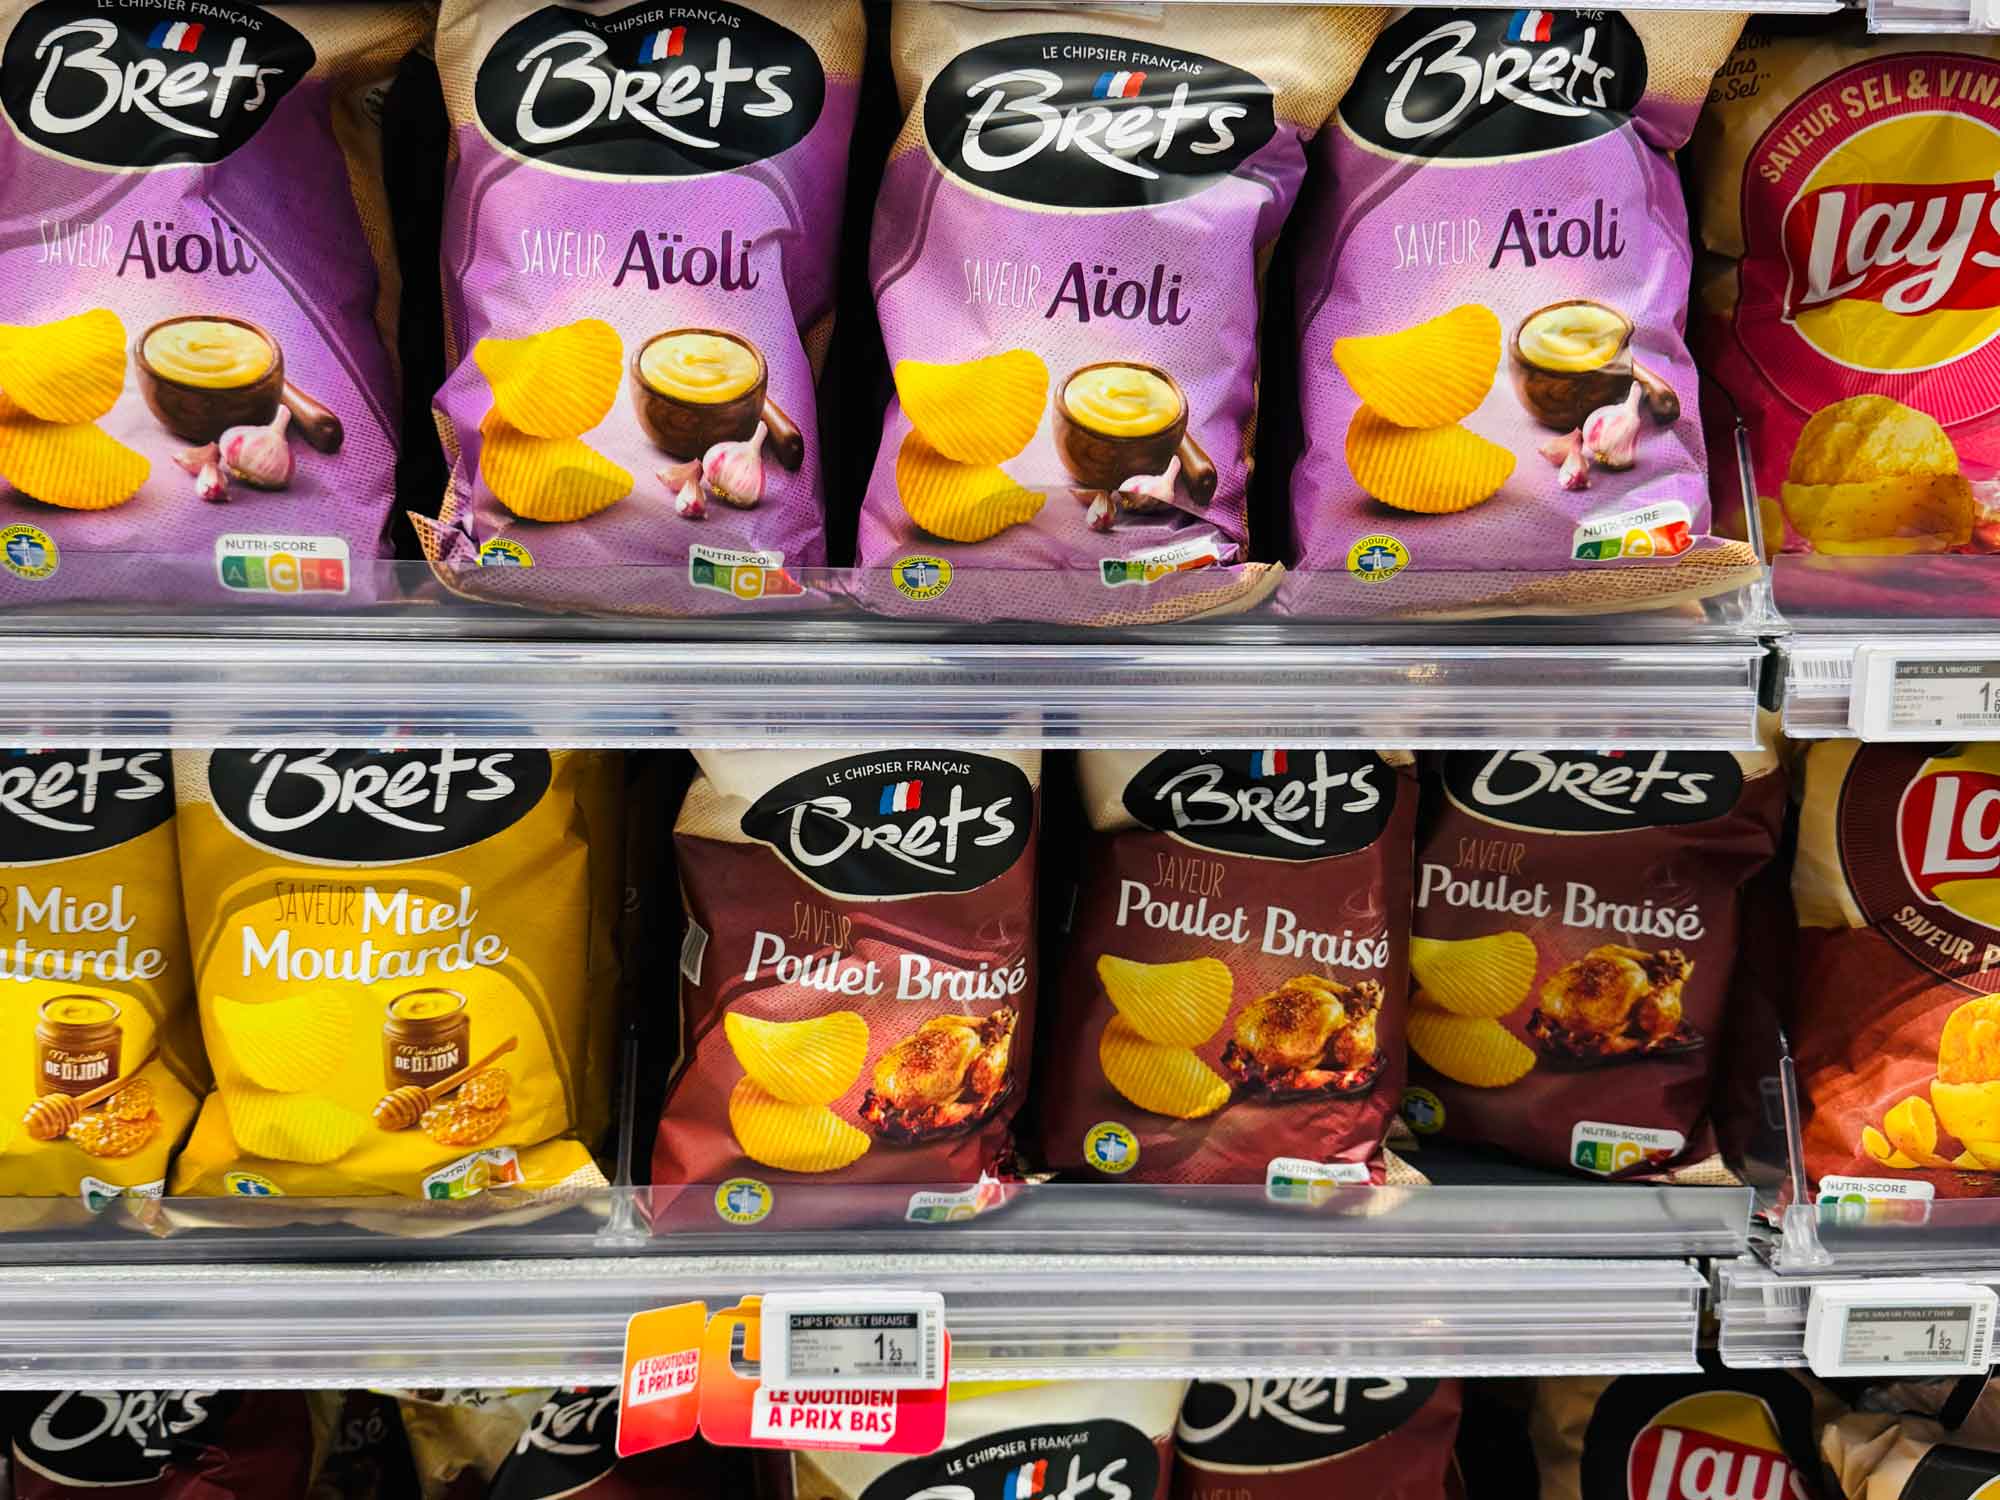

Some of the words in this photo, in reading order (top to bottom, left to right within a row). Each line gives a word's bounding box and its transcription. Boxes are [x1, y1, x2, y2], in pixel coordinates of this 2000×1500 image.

[190, 2, 264, 31] FRANÇAIS
[604, 9, 664, 34] CHIPSIER
[669, 7, 741, 29] FRANÇAIS
[30, 18, 284, 139] Brets
[1042, 46, 1058, 60] LE
[1063, 46, 1128, 63] CHIPSIER
[1131, 52, 1203, 75] FRANÇAIS
[1384, 20, 1615, 139] Brets
[517, 30, 793, 148] Brets
[961, 69, 1247, 180] Brets
[1760, 104, 1840, 183] SAVEUR
[1840, 73, 1902, 119] SEL
[1907, 69, 1929, 99] &
[37, 219, 115, 268] SAVEUR
[117, 216, 259, 280] Aïoli
[1393, 219, 1481, 270] SAVEUR
[1488, 199, 1625, 270] Aïoli
[519, 229, 607, 278] SAVEUR
[612, 229, 759, 291] Aïoli
[963, 259, 1041, 310] SAVEUR
[1044, 262, 1191, 326] Aïoli
[225, 539, 318, 552] NUTRI-SCORE
[1583, 510, 1661, 537] NUTRSCORE
[697, 547, 776, 566] NUTRI-SCO
[0, 748, 164, 832] rets
[826, 773, 841, 786] LE
[844, 761, 902, 780] CHIPSIER
[907, 761, 971, 775] FRANÇAIS
[1154, 750, 1380, 846] Brets
[777, 785, 1015, 875] Brets
[1154, 852, 1225, 898] SAVEUR
[1454, 836, 1526, 875] SAVEUR
[16, 885, 137, 934] Miel
[275, 882, 356, 926] SAVEUR
[361, 886, 478, 936] Miel
[1115, 879, 1250, 944] Poulet
[1261, 906, 1390, 970] Braisé
[1417, 863, 1551, 918] Poulet
[1563, 881, 1705, 940] Braisé
[790, 901, 853, 951] SAVEUR
[1893, 906, 1975, 964] SAVEUR
[0, 936, 168, 983] tarde
[241, 925, 509, 985] Moutarde
[744, 931, 884, 996] Poulet
[896, 953, 1028, 1001] Braisé
[61, 1058, 109, 1081] DIJON
[394, 1055, 411, 1070] DE
[411, 1047, 459, 1072] DIJON
[1581, 1126, 1659, 1144] NUTRI-SCORE
[1826, 1181, 1908, 1194] NUTRI-SCORE
[791, 1317, 823, 1327] CHIPS
[825, 1316, 868, 1327] POULET
[871, 1315, 909, 1326] BRAISE
[1938, 1338, 1952, 1350] 52
[640, 1361, 648, 1375] LE
[651, 1350, 697, 1373] QUOTIDIEN
[874, 1333, 884, 1360] 1
[890, 1348, 902, 1361] 23
[648, 1373, 673, 1393] PRIX
[677, 1366, 697, 1386] BAS
[769, 1389, 789, 1402] LE
[794, 1389, 894, 1407] QUOTIDIEN
[790, 1408, 843, 1431] PRIX
[850, 1411, 892, 1433] BAS
[946, 1463, 963, 1476] LE
[966, 1442, 1026, 1468] CHIPSIER
[1030, 1432, 1089, 1451] FRANÇAIS
